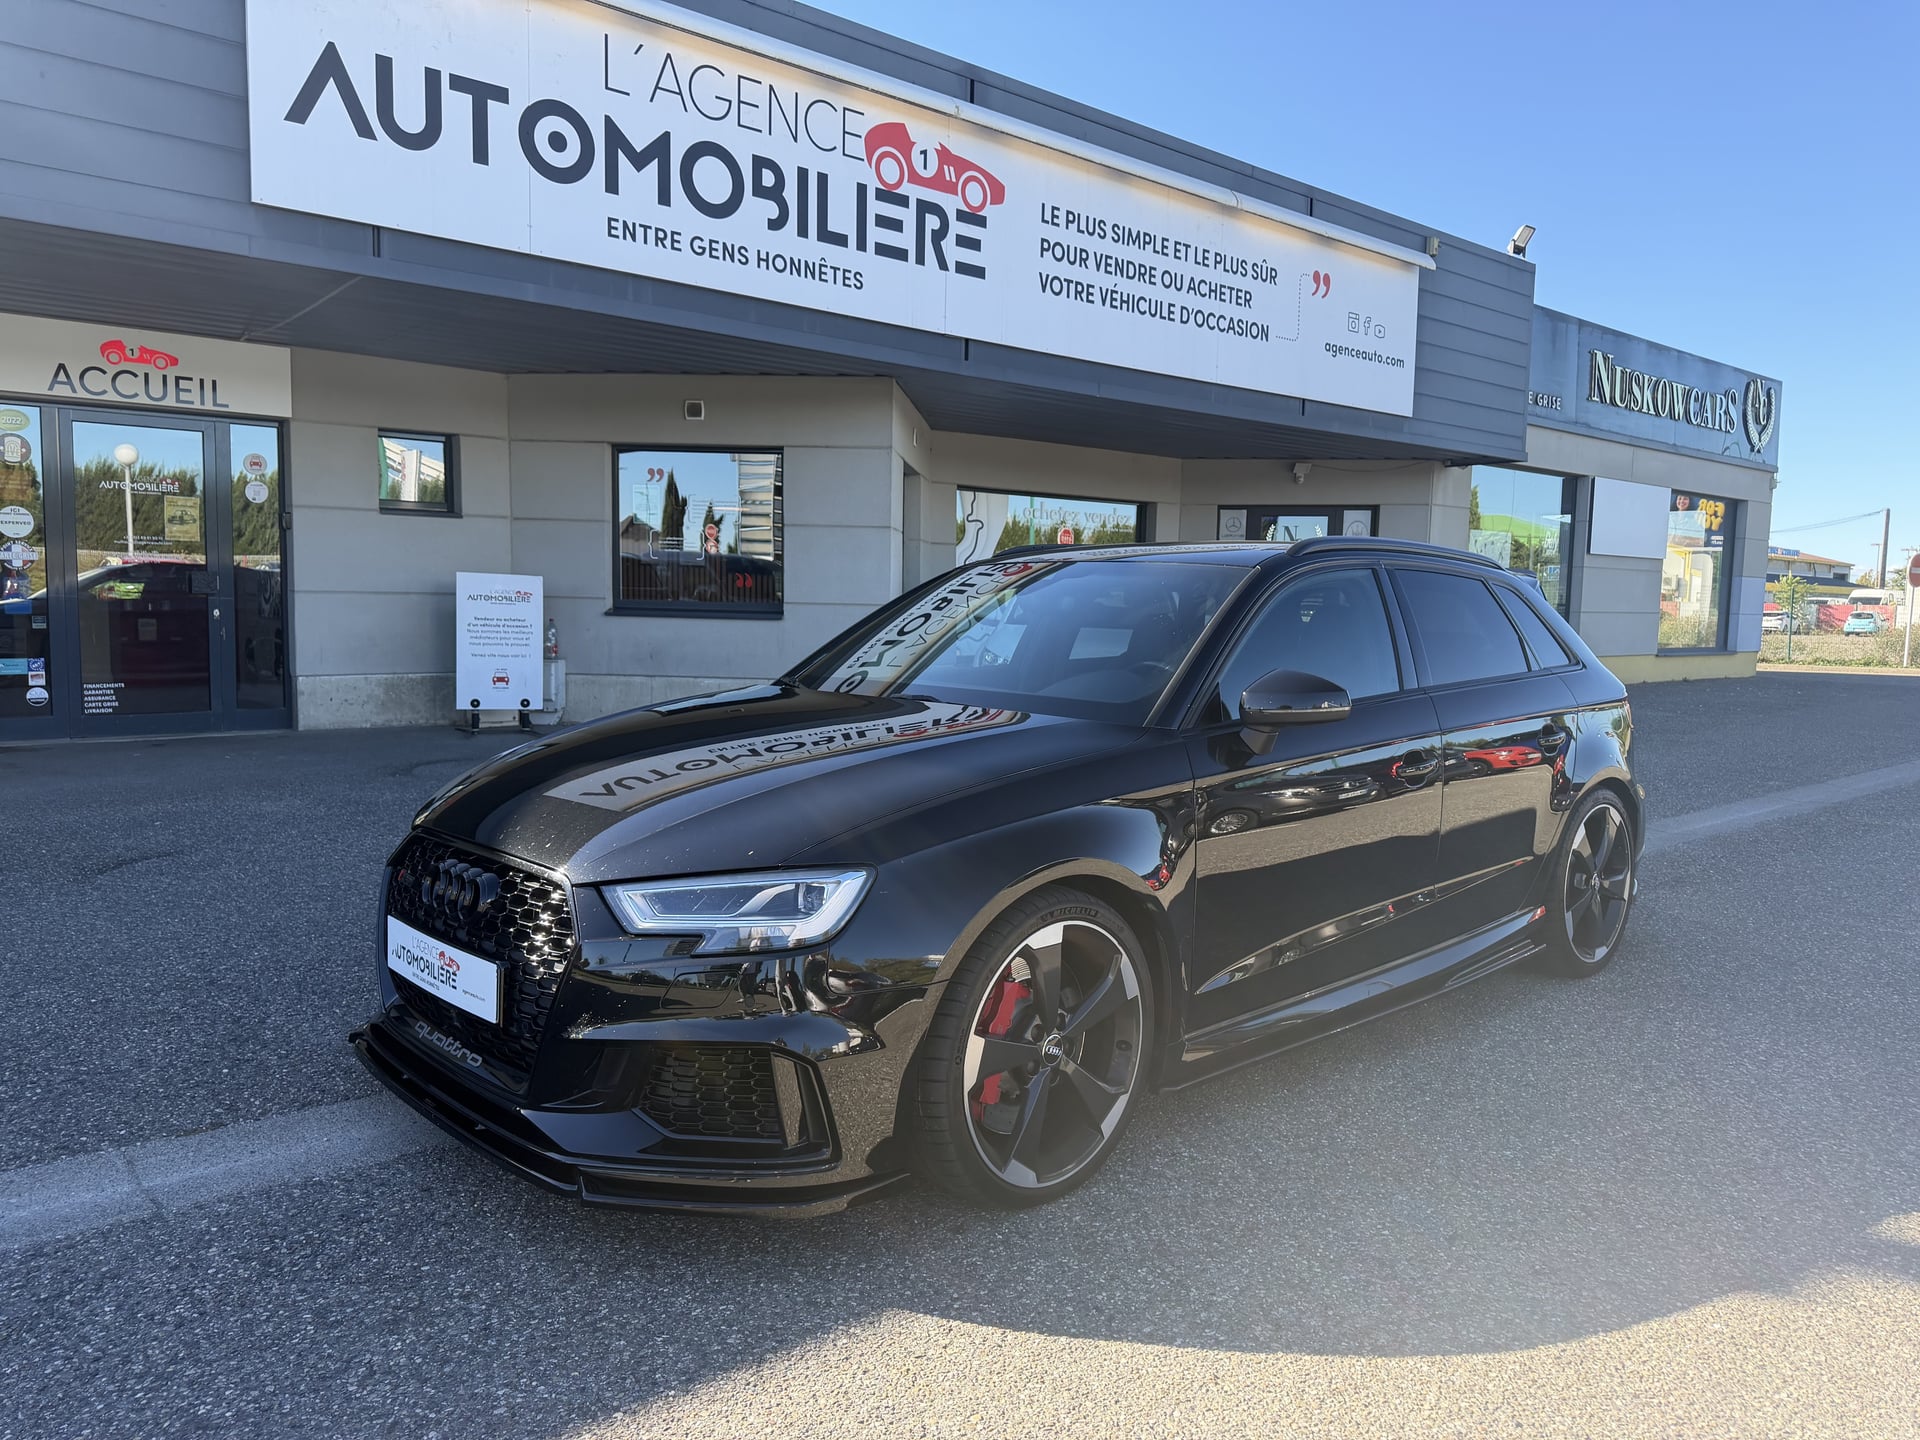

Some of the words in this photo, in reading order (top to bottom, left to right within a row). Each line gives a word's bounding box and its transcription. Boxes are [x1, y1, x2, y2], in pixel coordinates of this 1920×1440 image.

[603, 33, 866, 162] L'AGENCE
[607, 217, 682, 252] ENTRE
[691, 235, 748, 264] GENS
[758, 253, 864, 291] HONNÊTES
[1040, 203, 1060, 227] LE
[1065, 210, 1107, 240] PLUS
[1111, 225, 1169, 257] SIMPLE
[1173, 240, 1191, 261] ET
[1195, 246, 1210, 267] LE
[1214, 252, 1248, 277] PLUS
[1251, 259, 1278, 286] SÛR
[1040, 237, 1088, 269] POUR
[1094, 252, 1157, 286] VENDRE
[1161, 270, 1184, 291] OU
[1186, 276, 1253, 309] ACHETER
[1038, 272, 1095, 304] VOTRE
[1099, 283, 1176, 322] VÉHICULE
[1180, 305, 1270, 342] D'OCCASION
[1324, 341, 1405, 369] agenceauto.com
[48, 363, 229, 409] ACCUEIL
[1537, 393, 1562, 410] GRISE
[1056, 906, 1099, 918] MICHELIN
[414, 1020, 482, 1068] quattro
